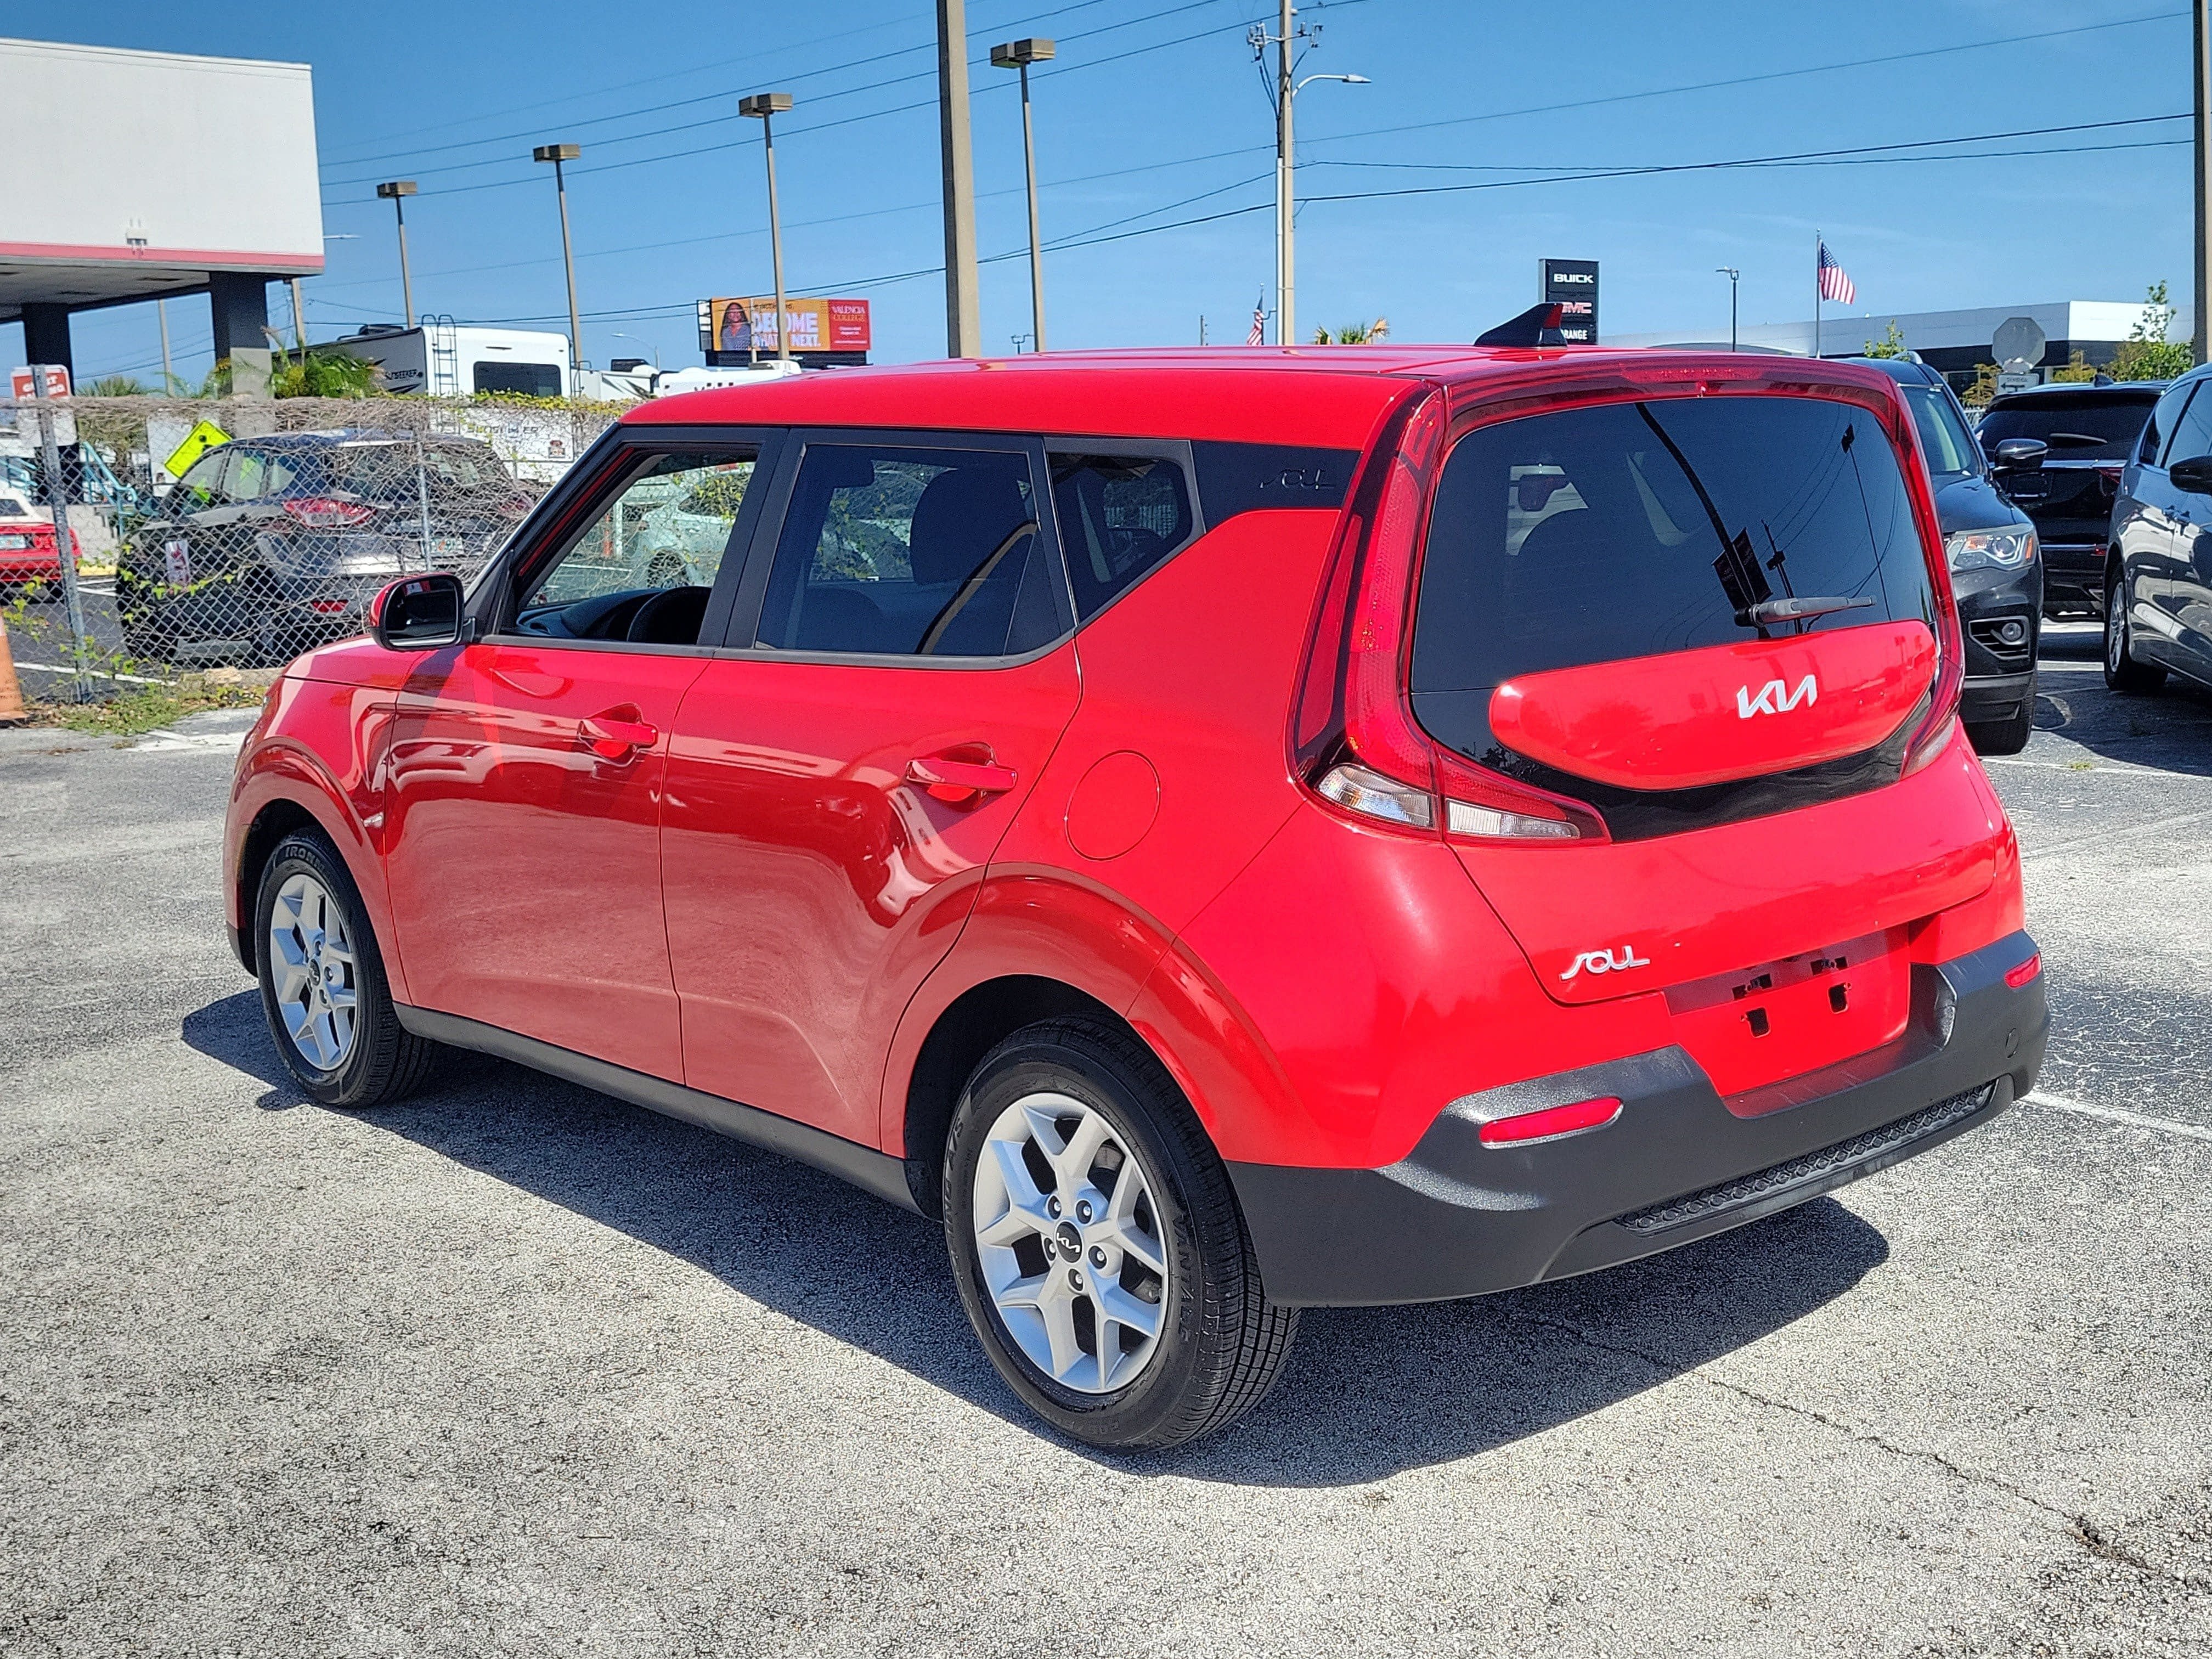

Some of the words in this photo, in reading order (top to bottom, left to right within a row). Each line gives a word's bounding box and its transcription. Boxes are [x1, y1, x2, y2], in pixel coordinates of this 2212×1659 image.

[1553, 273, 1594, 283] BUICK
[1560, 329, 1588, 340] RANGE
[1560, 945, 1651, 980] SOUL
